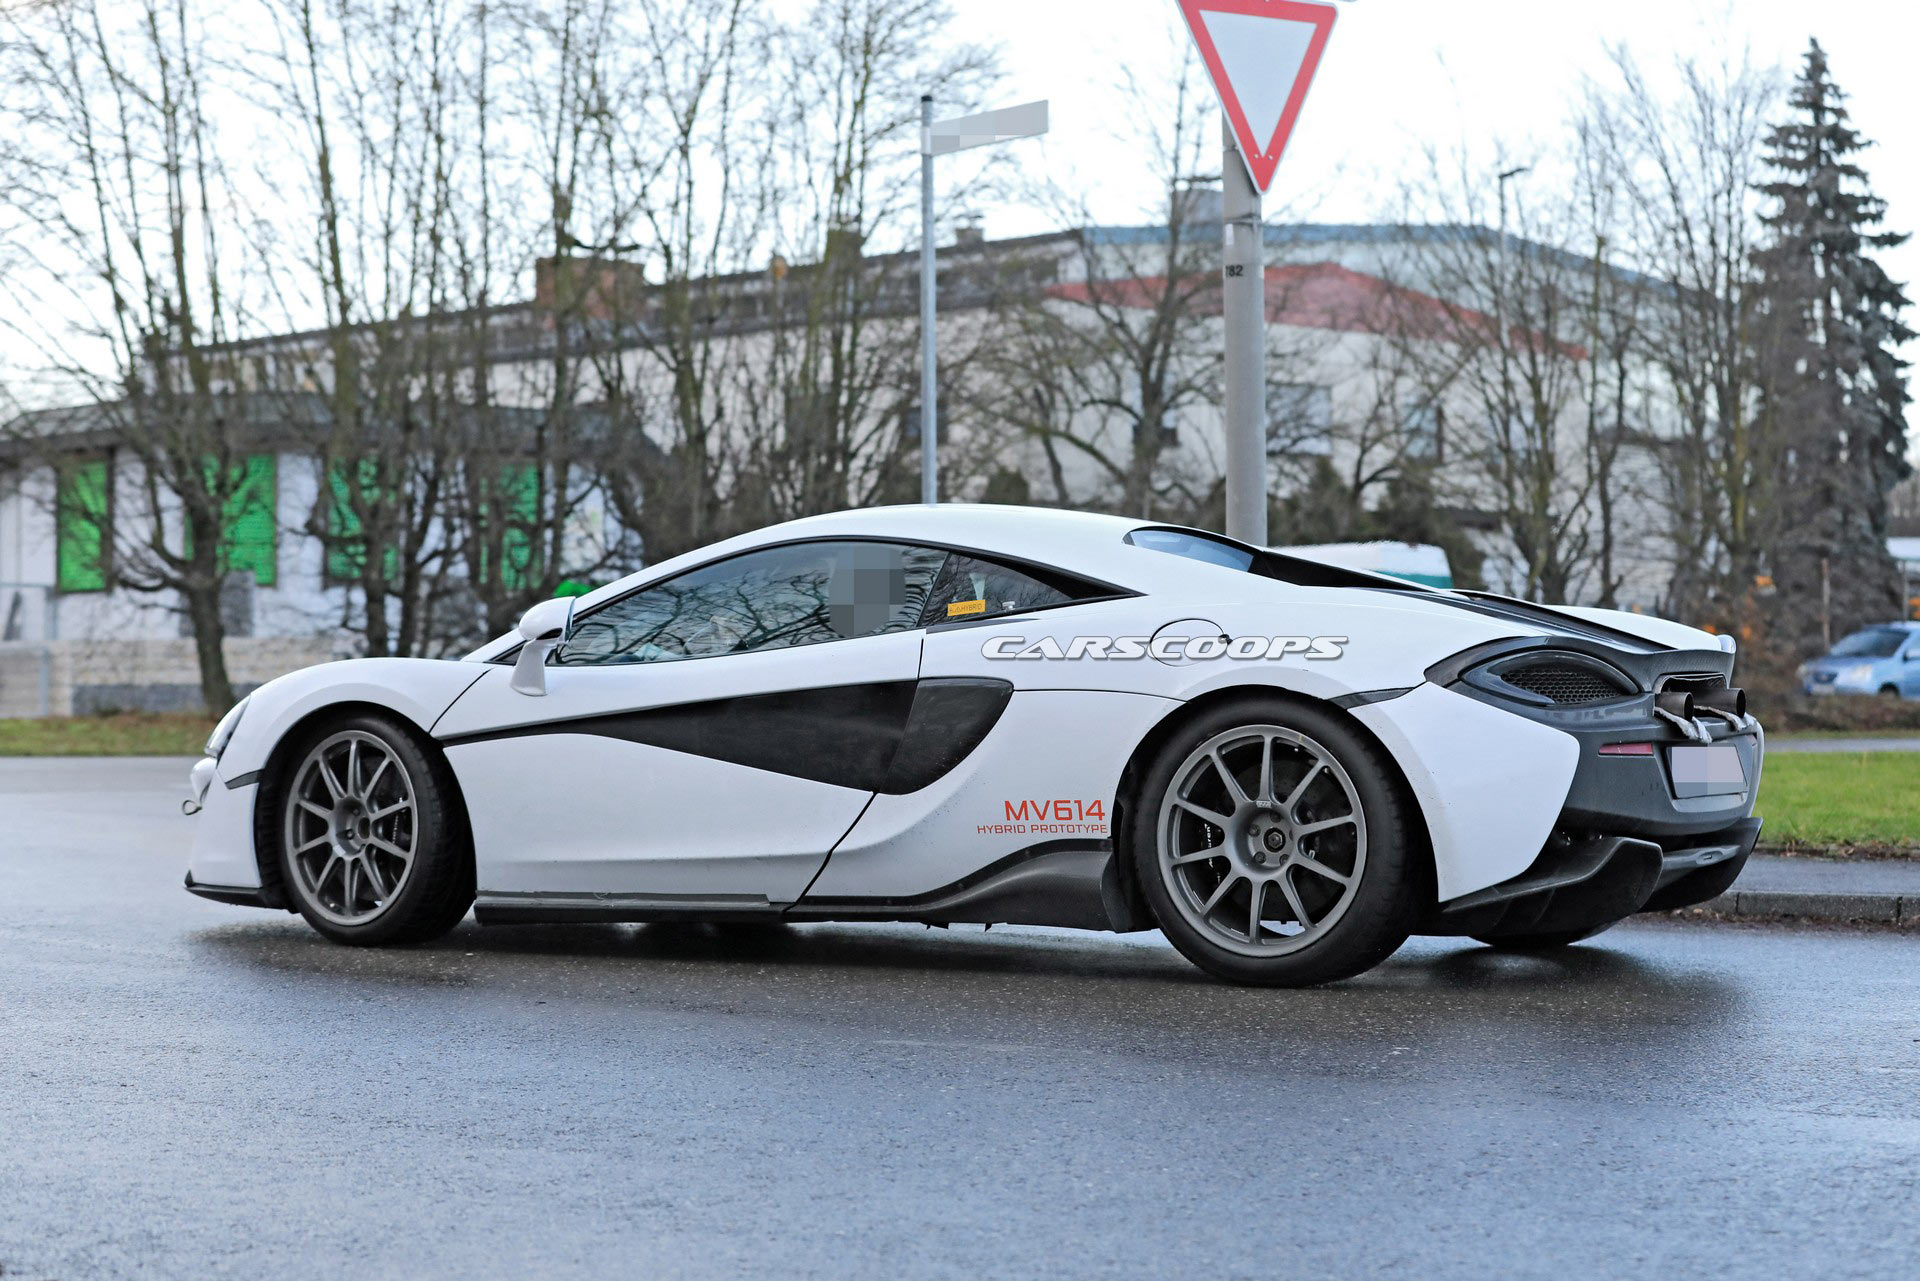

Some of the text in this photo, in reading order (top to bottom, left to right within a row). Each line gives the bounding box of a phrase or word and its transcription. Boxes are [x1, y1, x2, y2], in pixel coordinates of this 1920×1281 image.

[1004, 799, 1106, 821] MV614
[977, 823, 1108, 834] HYBRID PROTOTYPE
